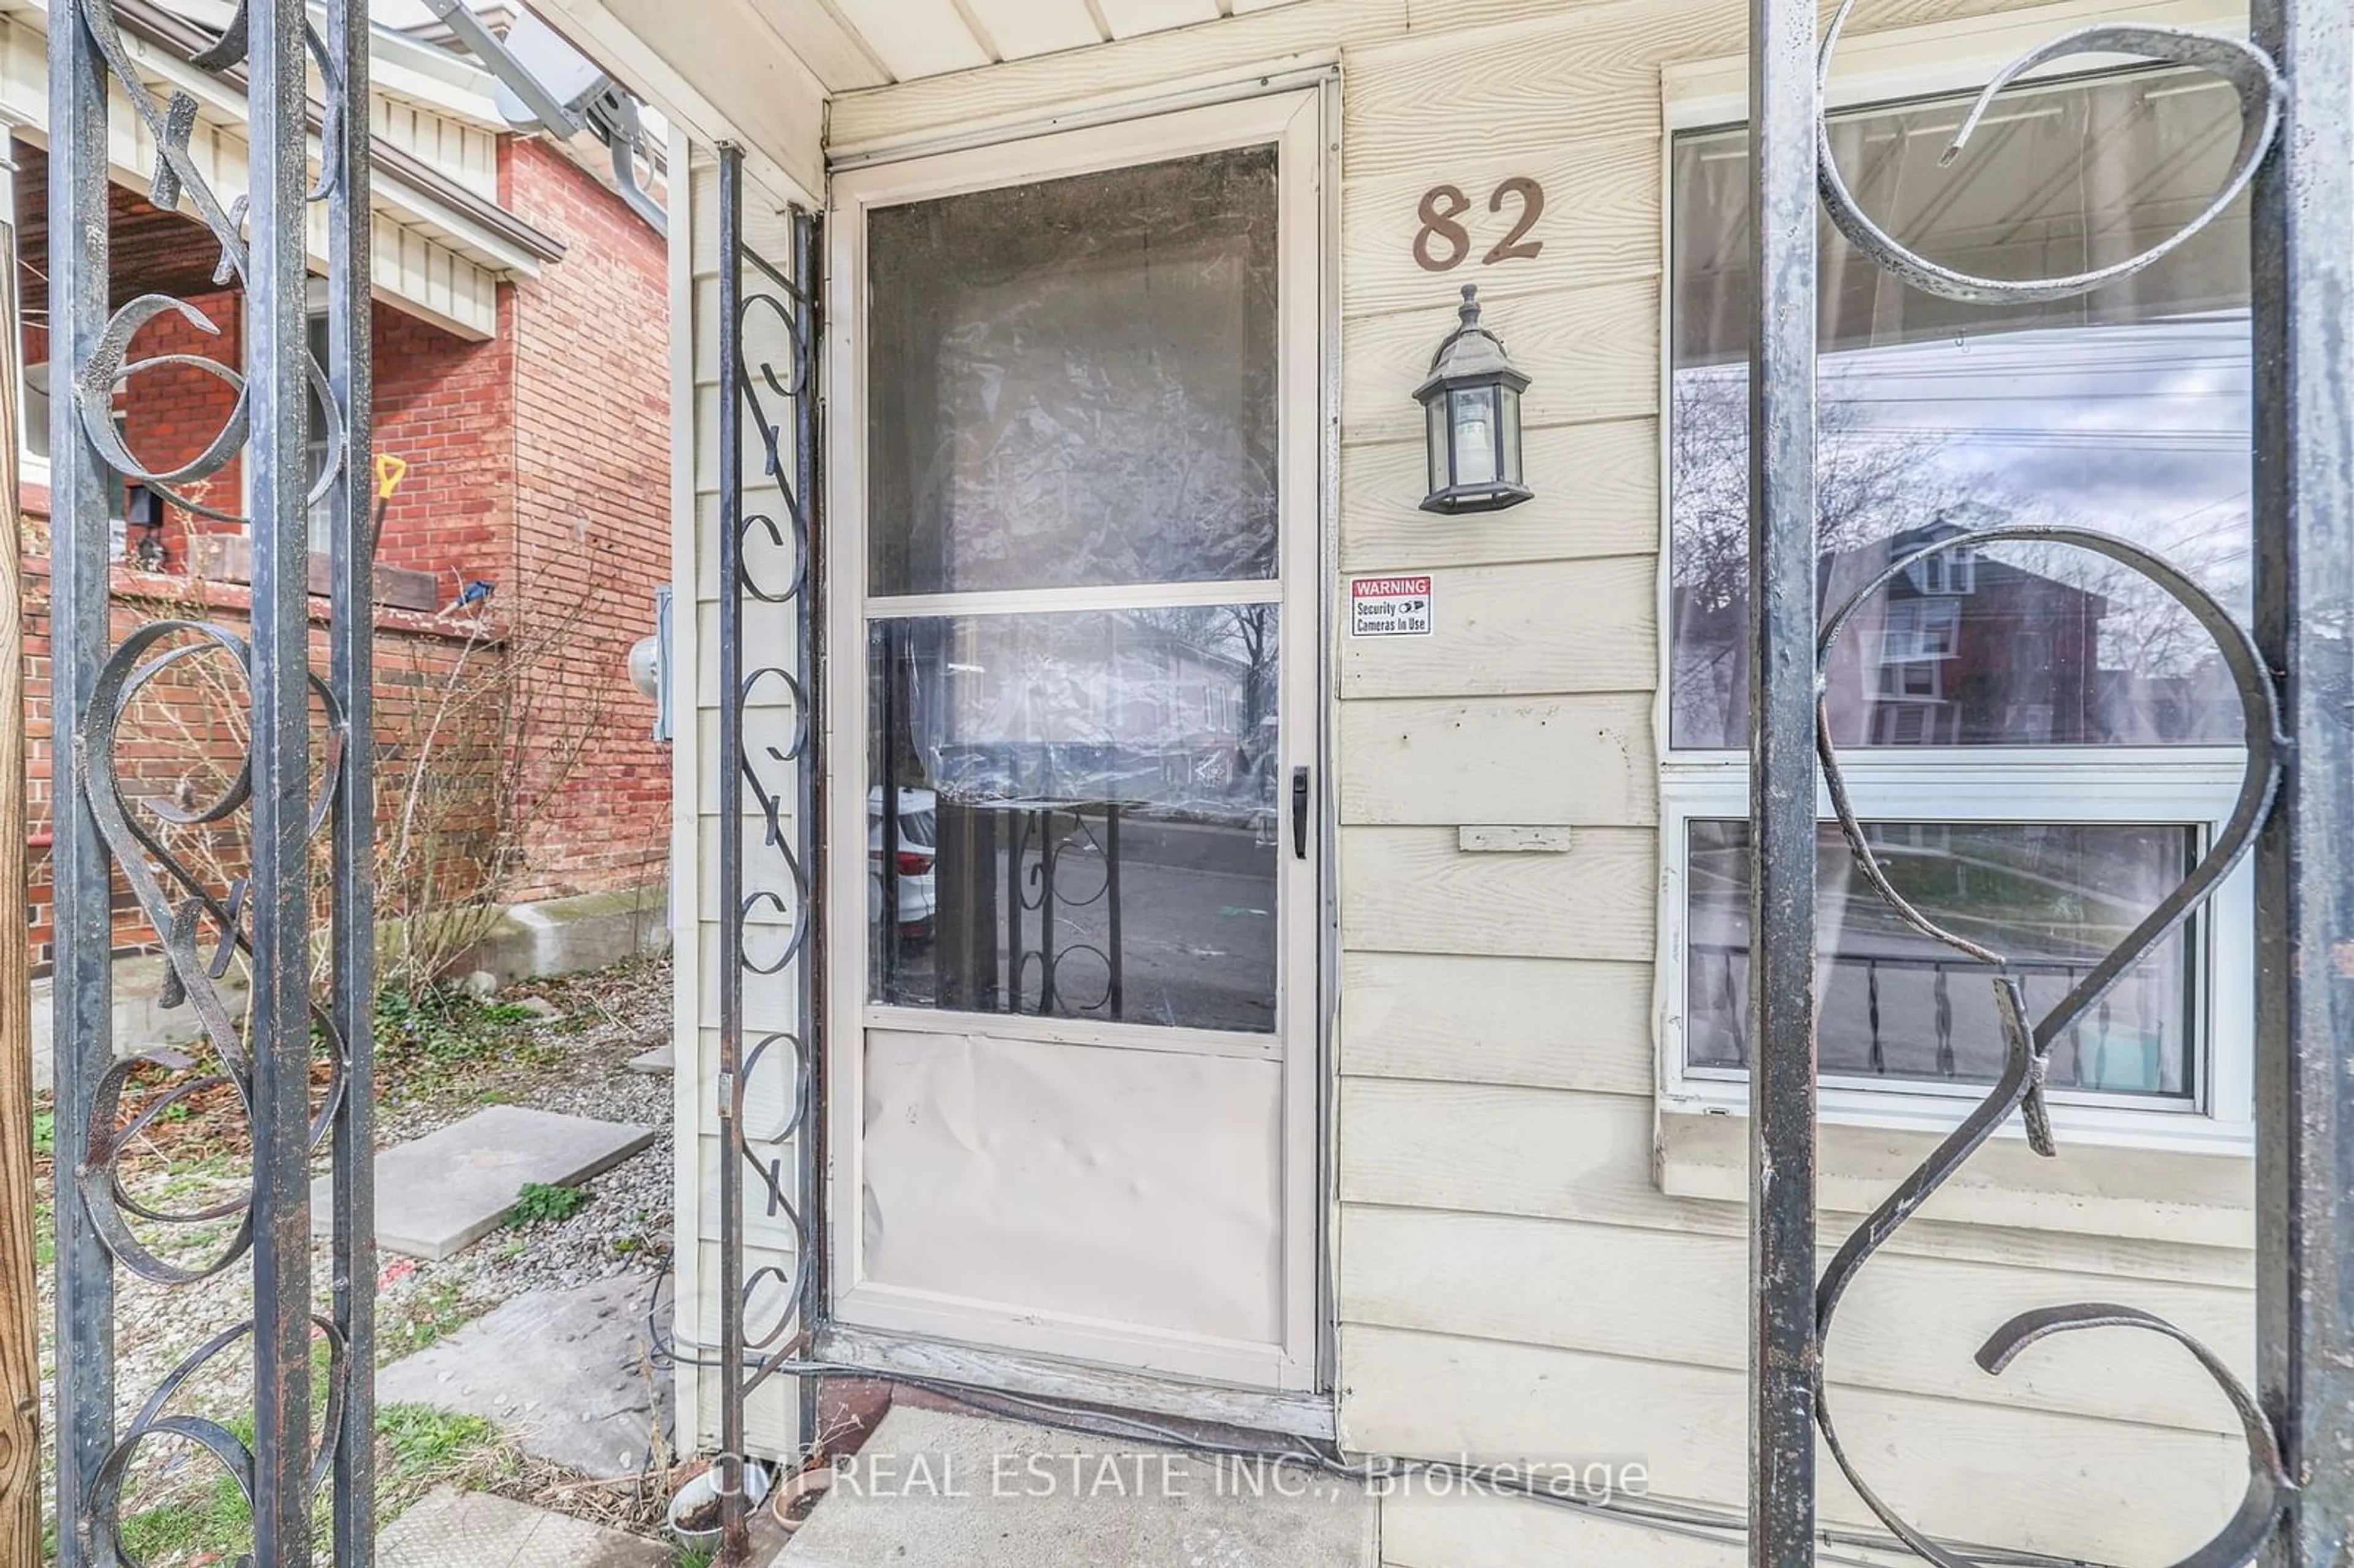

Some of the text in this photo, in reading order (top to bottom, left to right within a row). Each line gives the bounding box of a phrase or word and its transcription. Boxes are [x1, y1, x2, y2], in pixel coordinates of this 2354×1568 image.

[1412, 177, 1544, 272] 82
[1357, 579, 1426, 595] WARNING
[1357, 601, 1396, 616] Security
[1357, 617, 1425, 631] Cameras In Use
